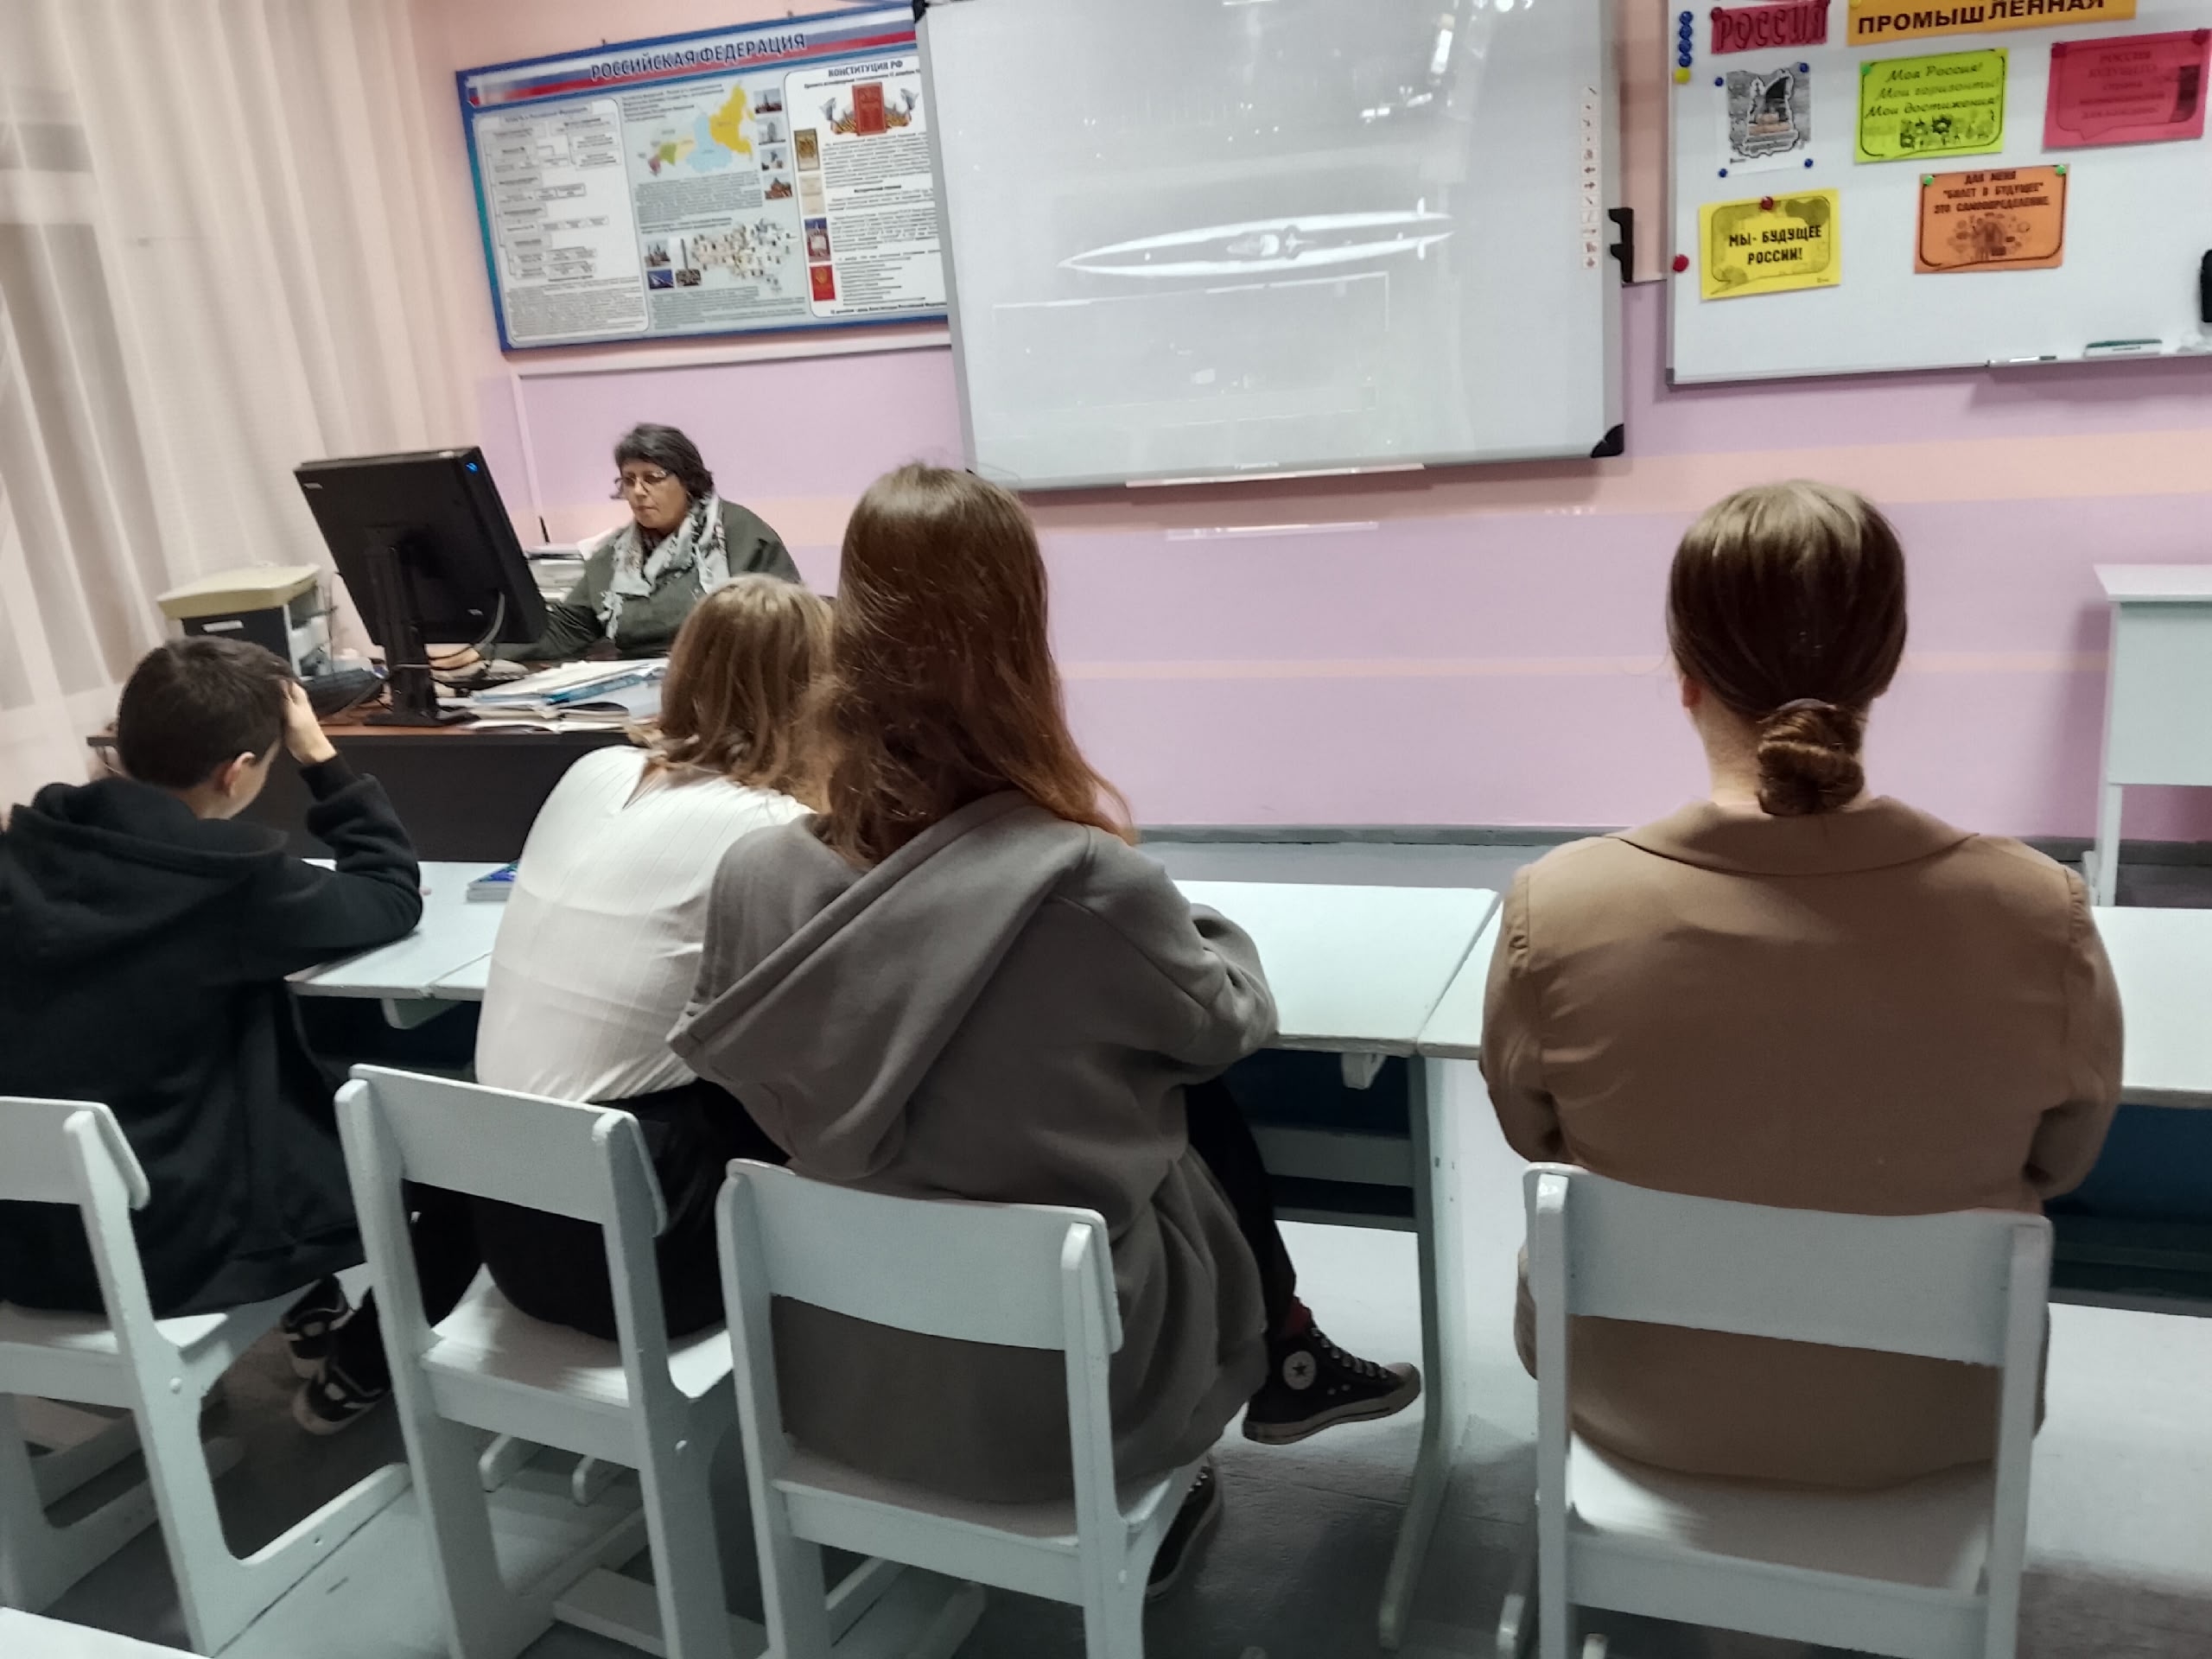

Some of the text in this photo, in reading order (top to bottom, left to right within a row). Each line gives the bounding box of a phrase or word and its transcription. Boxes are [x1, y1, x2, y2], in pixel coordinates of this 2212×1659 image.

[1714, 6, 1827, 52] РОССИЯ
[591, 34, 806, 80] РОССИЙСКАЯ ФЕДЕРАЦИЯ
[828, 60, 904, 78] КОНСТИТУЦИЯ РФ
[1885, 69, 1920, 83] Моя
[1864, 105, 1898, 118] Мои
[1762, 225, 1821, 244] БУДУЩЕЕ
[1747, 248, 1802, 265] РОССИИ!
